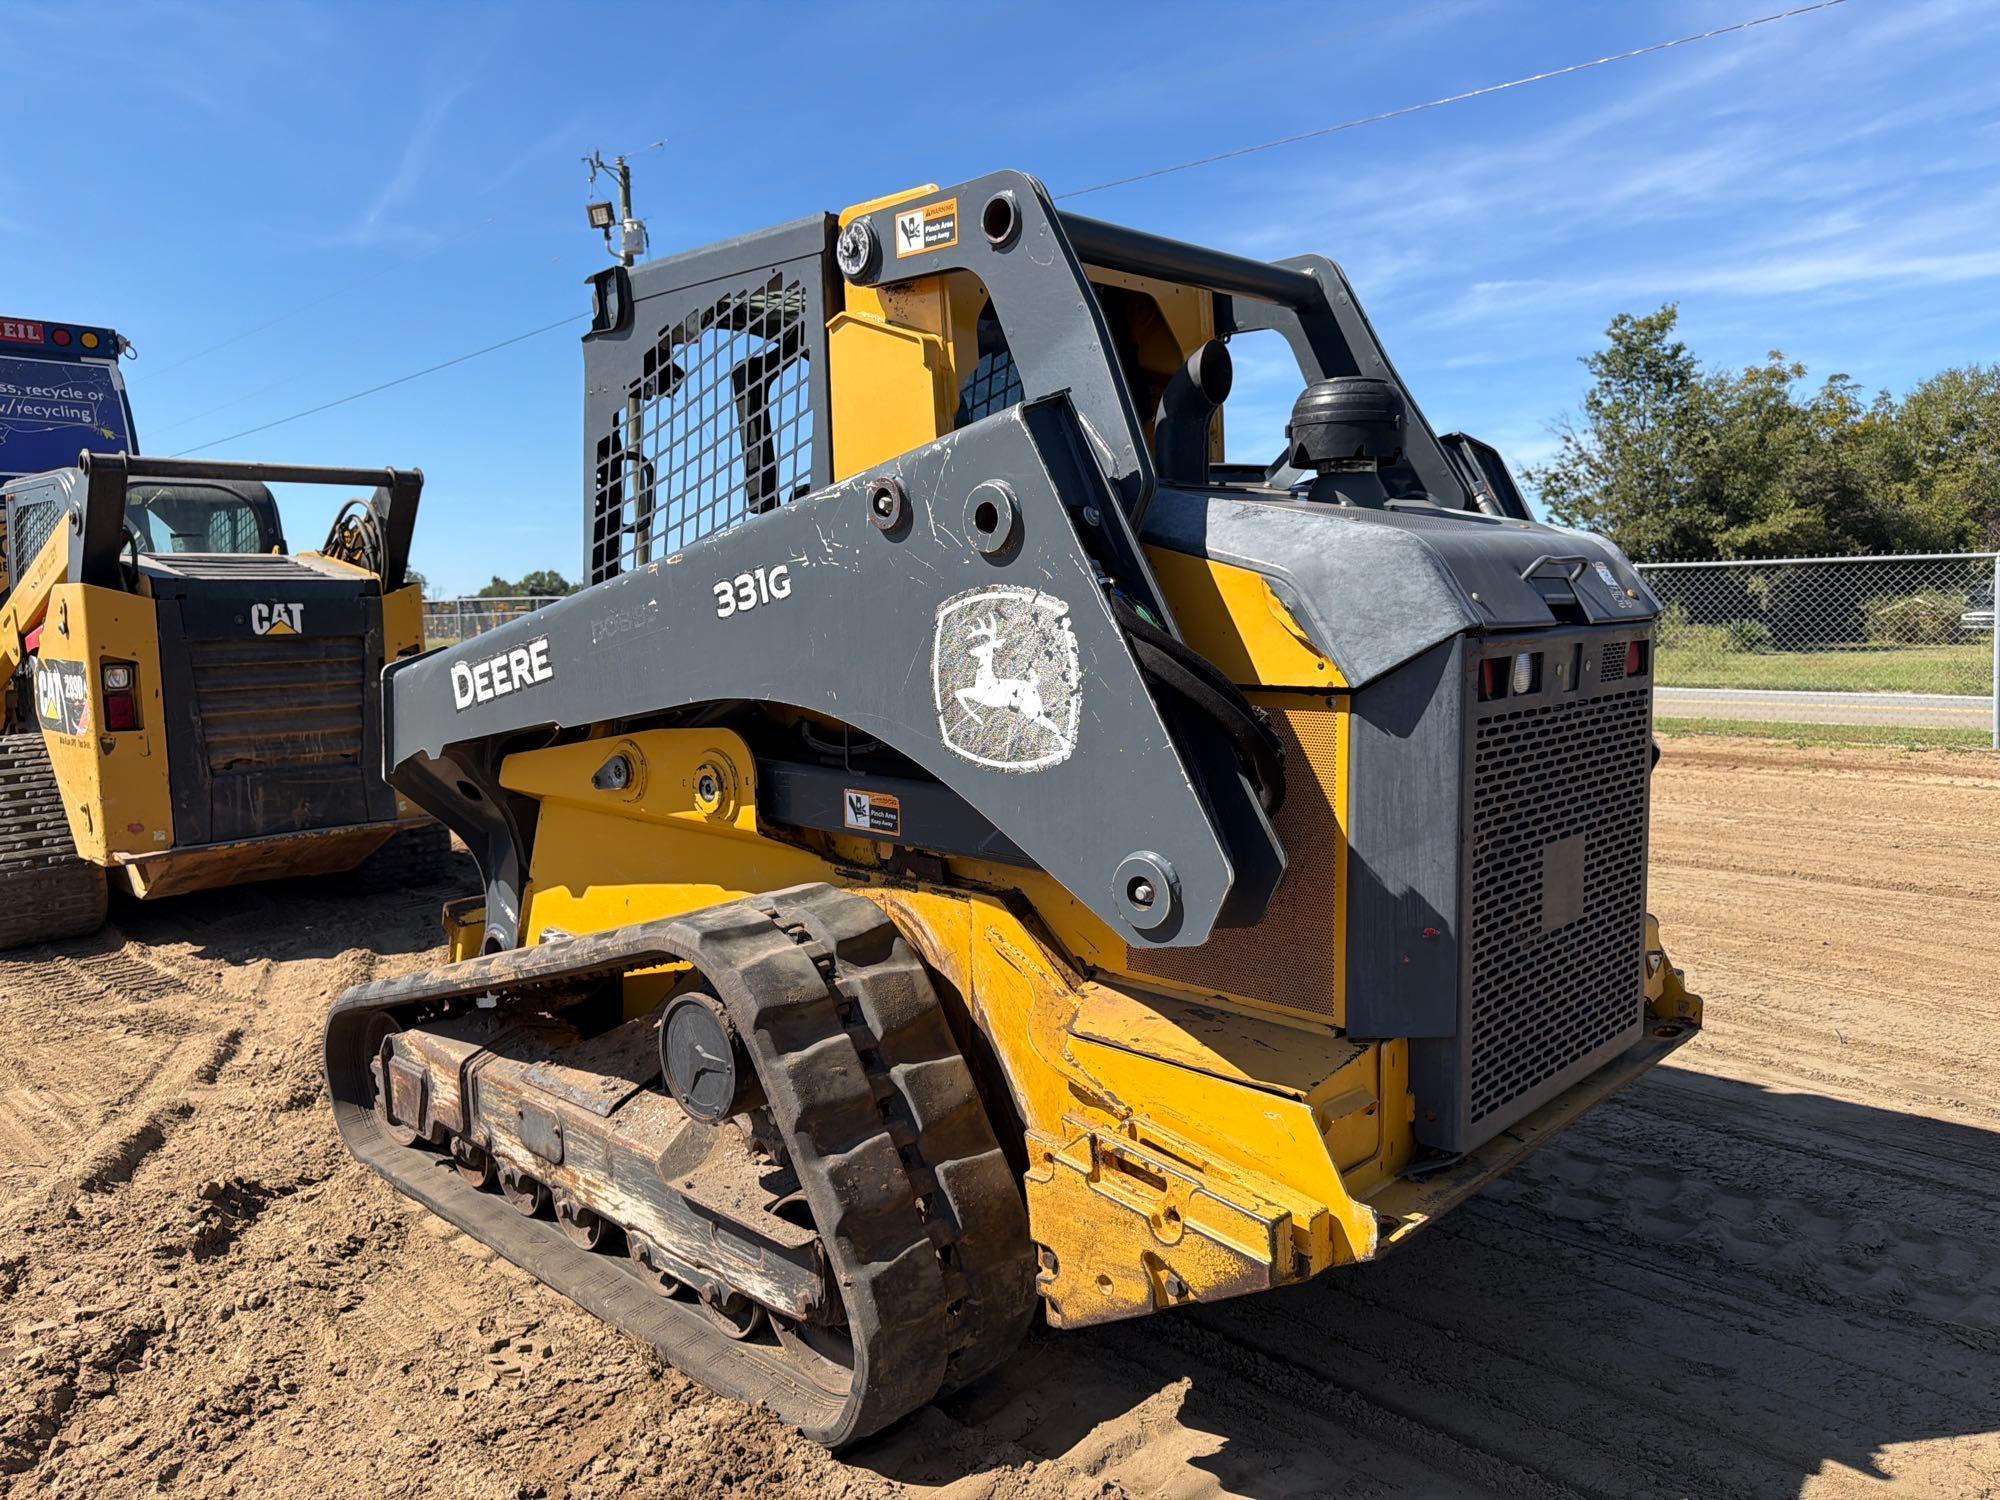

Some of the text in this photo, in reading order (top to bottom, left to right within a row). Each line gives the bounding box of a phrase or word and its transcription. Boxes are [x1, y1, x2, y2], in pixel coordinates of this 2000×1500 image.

[925, 223, 940, 233] Pinch
[0, 322, 40, 340] EIL
[26, 386, 83, 399] recycle
[88, 392, 104, 400] or
[713, 565, 792, 618] 331G
[251, 603, 305, 635] CAT
[450, 638, 553, 710] DEERE
[38, 670, 62, 720] CAT
